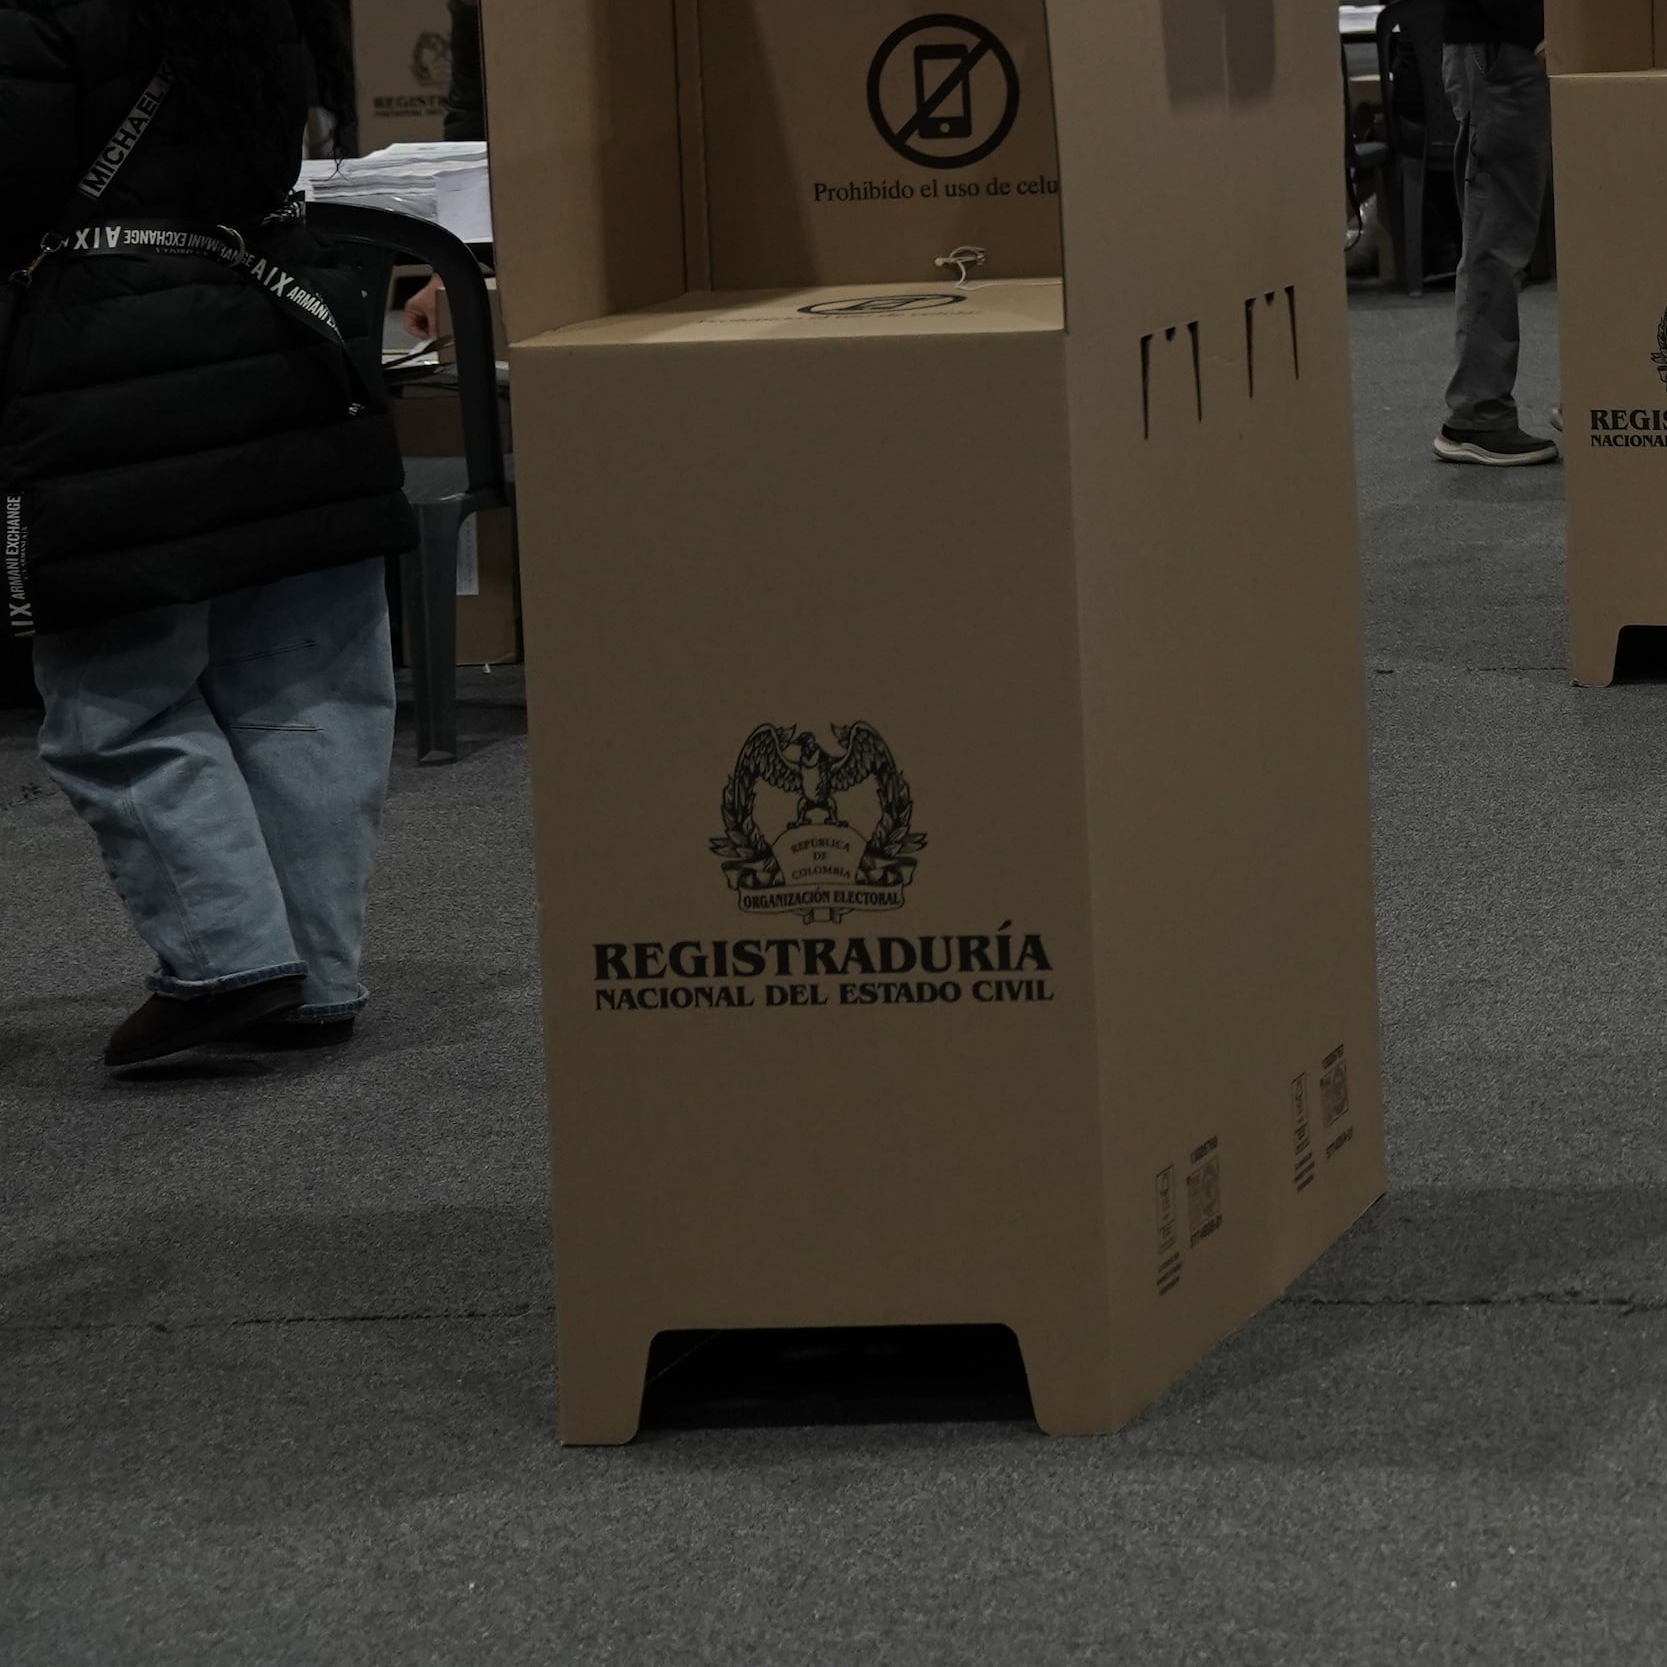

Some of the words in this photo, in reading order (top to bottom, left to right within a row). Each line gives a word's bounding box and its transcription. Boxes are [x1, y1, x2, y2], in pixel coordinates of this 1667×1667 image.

[82, 91, 162, 192] MICHAEL
[814, 180, 915, 202] Prohibido
[920, 179, 938, 198] el
[945, 182, 980, 198] uso
[986, 177, 1010, 196] de
[1016, 175, 1059, 196] celu
[123, 228, 187, 248] EXCHANGE
[286, 285, 331, 322] ARMANI
[5, 495, 22, 556] EXCHANGE
[6, 557, 27, 601] ARMANI
[790, 837, 851, 854] REPÚBLICA
[814, 851, 827, 860] DE
[791, 865, 852, 880] COLOMBIA
[743, 887, 831, 909] ORGANIZACIÓN
[834, 889, 900, 906] ELECTORAL
[593, 919, 1054, 981] REGISTRADURÍA
[595, 983, 755, 1011] NACIONAL
[766, 983, 828, 1007] DEL
[839, 980, 962, 1005] ESTADO
[972, 978, 1055, 1003] CIVIL
